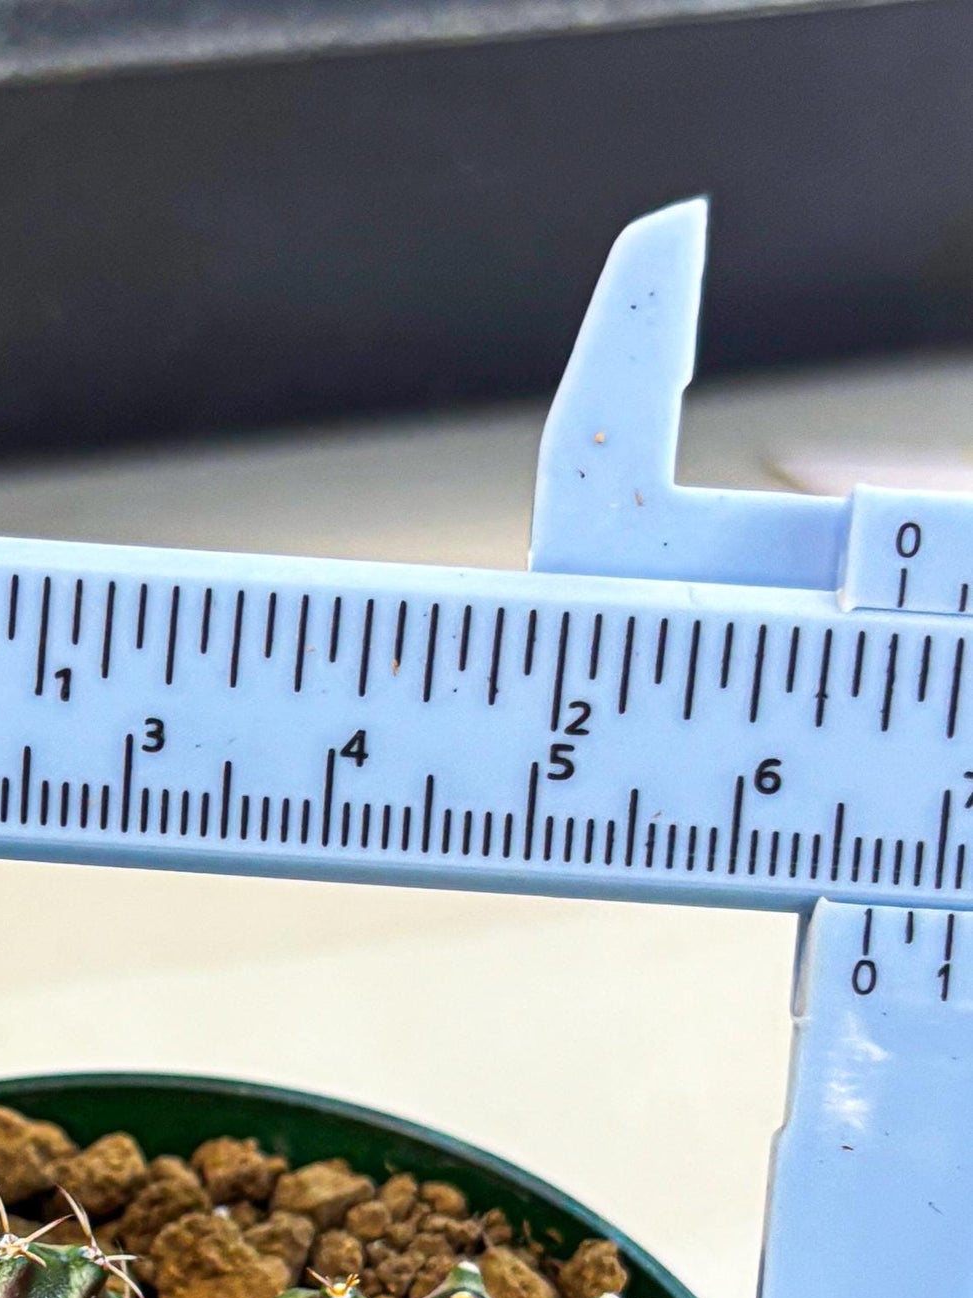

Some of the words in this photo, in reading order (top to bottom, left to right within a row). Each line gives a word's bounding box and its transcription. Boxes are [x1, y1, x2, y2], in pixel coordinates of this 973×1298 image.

[895, 521, 922, 559] 0
[54, 667, 73, 702] 1
[563, 700, 592, 736] 2
[141, 717, 166, 753] 3
[339, 729, 370, 768] 4
[546, 743, 576, 781] 5
[753, 757, 782, 795] 6
[851, 959, 878, 996] 0
[937, 963, 951, 1002] 1
